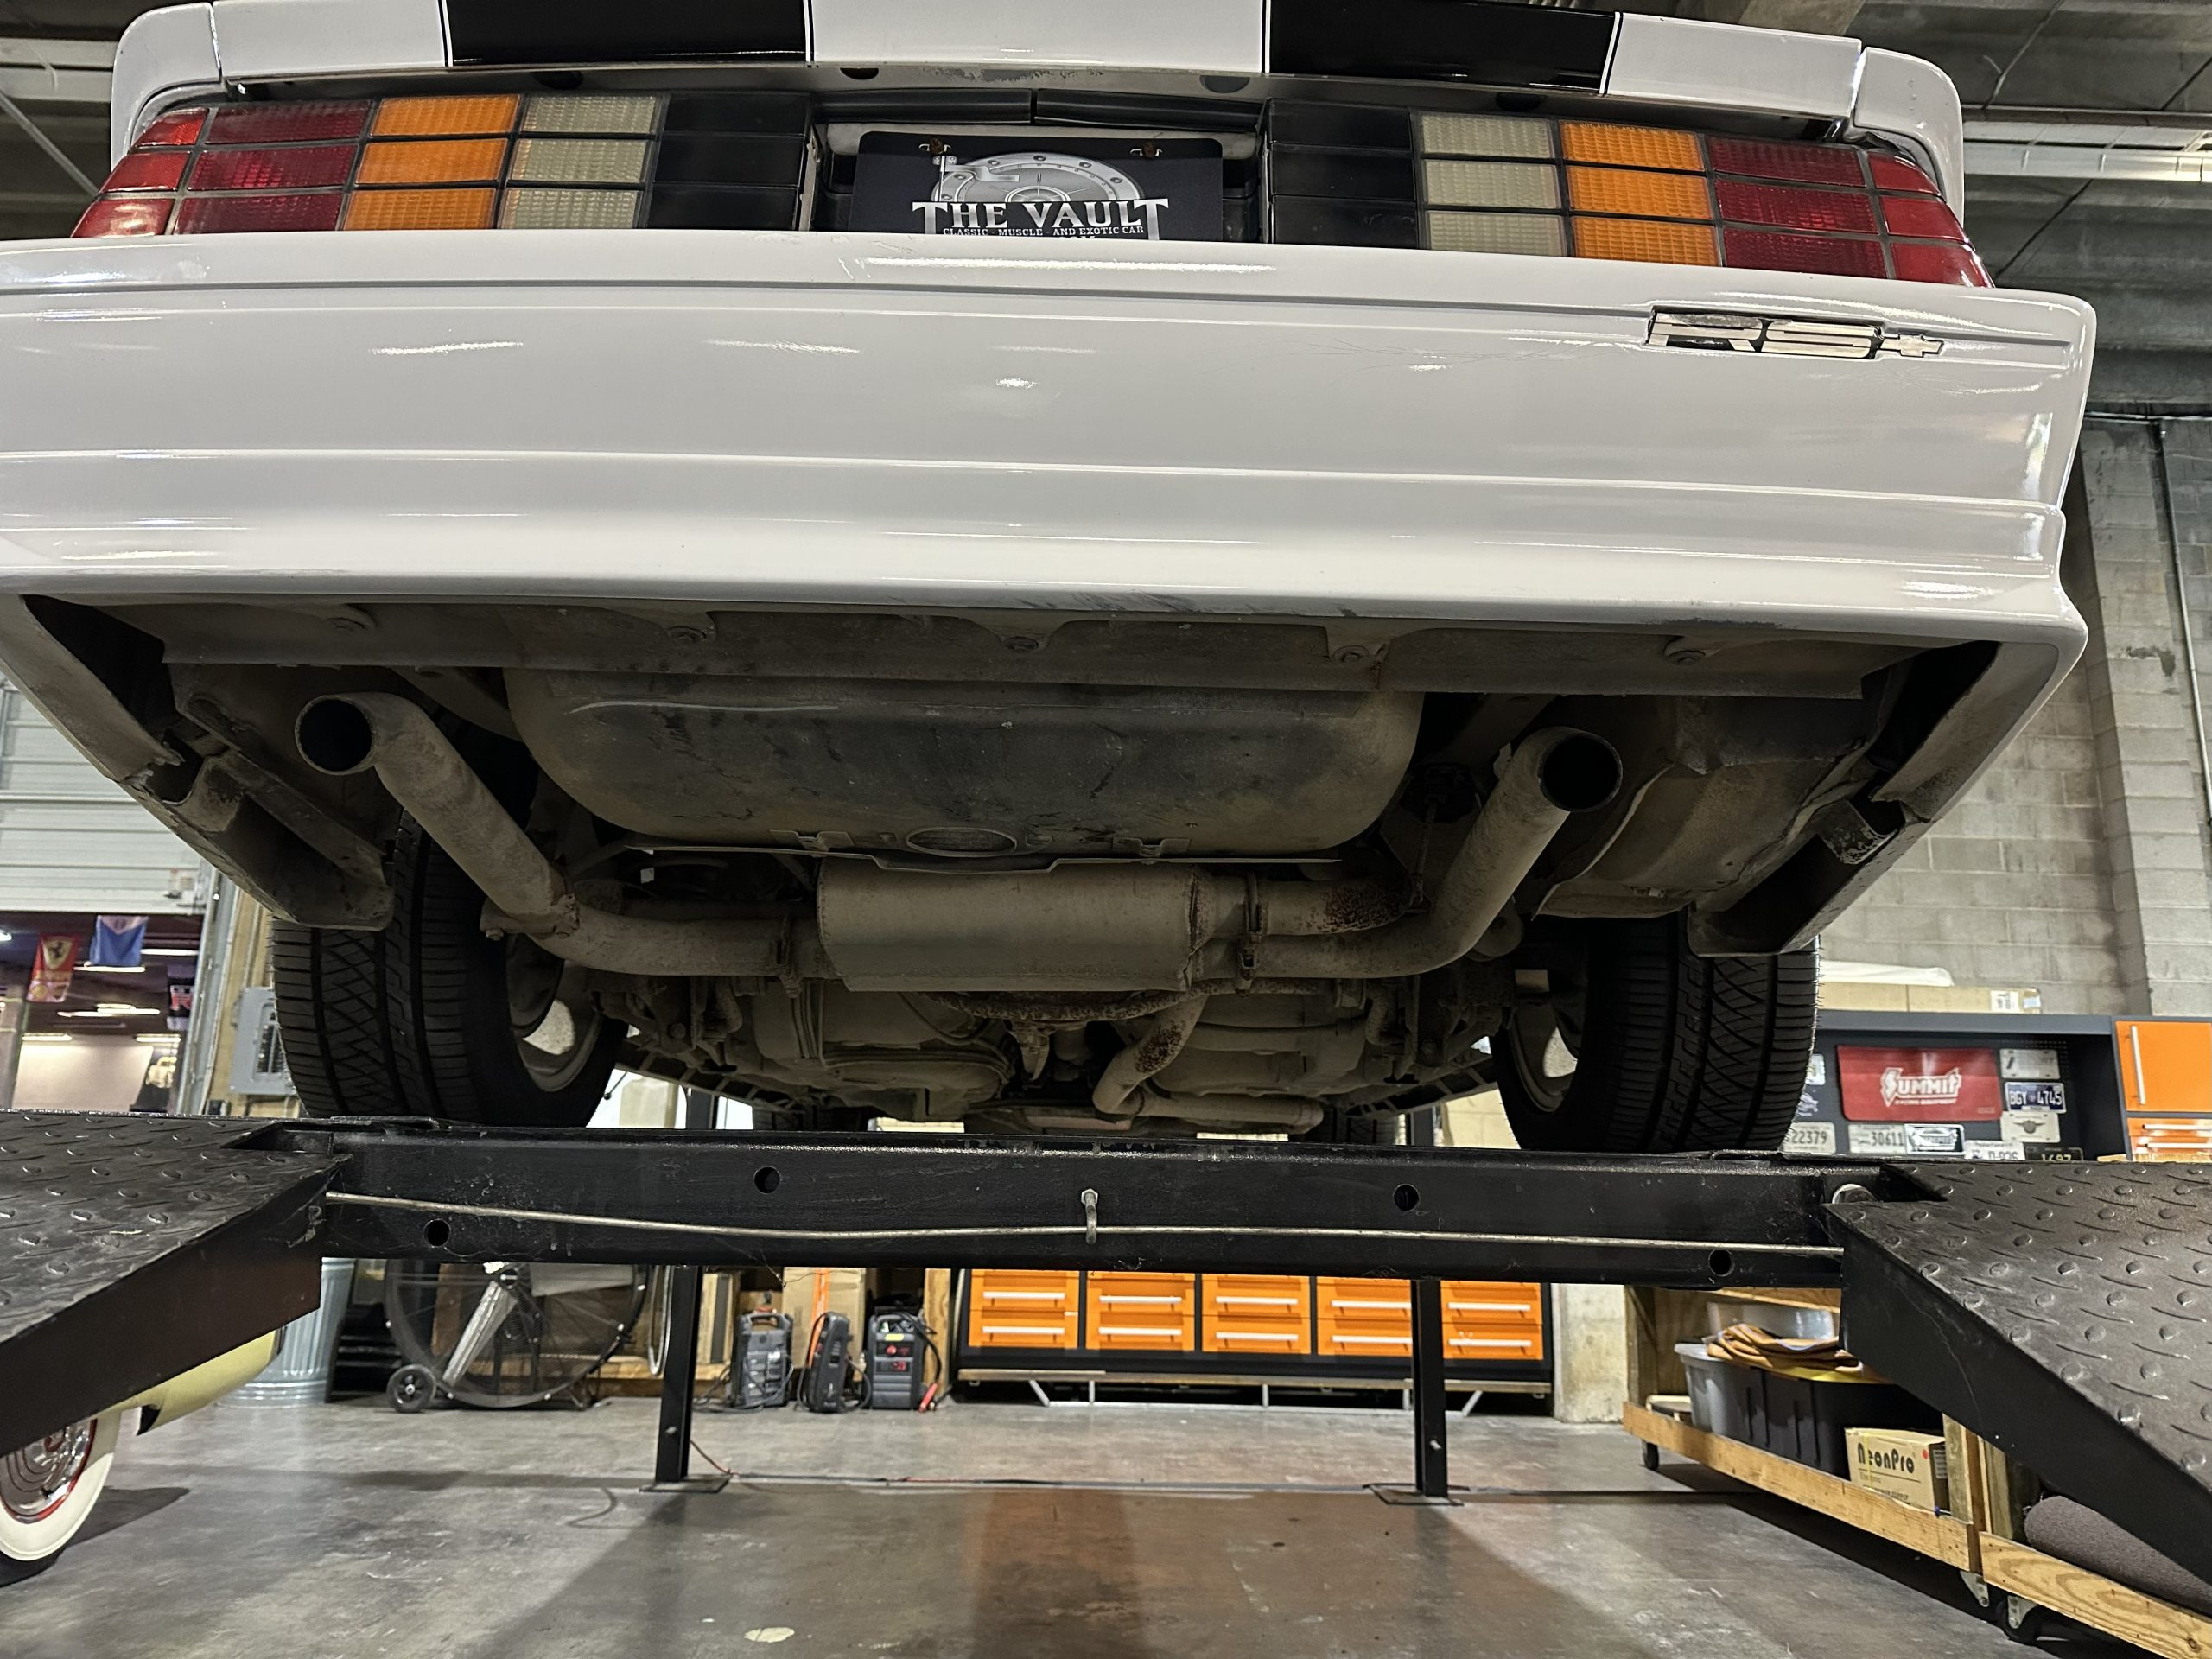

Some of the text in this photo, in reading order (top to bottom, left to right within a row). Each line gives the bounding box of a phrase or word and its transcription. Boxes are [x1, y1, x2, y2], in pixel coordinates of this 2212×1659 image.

[912, 198, 1169, 239] THE VAULT
[943, 226, 1145, 236] CLASSIC MUSCLE AND EXOTIC CAR
